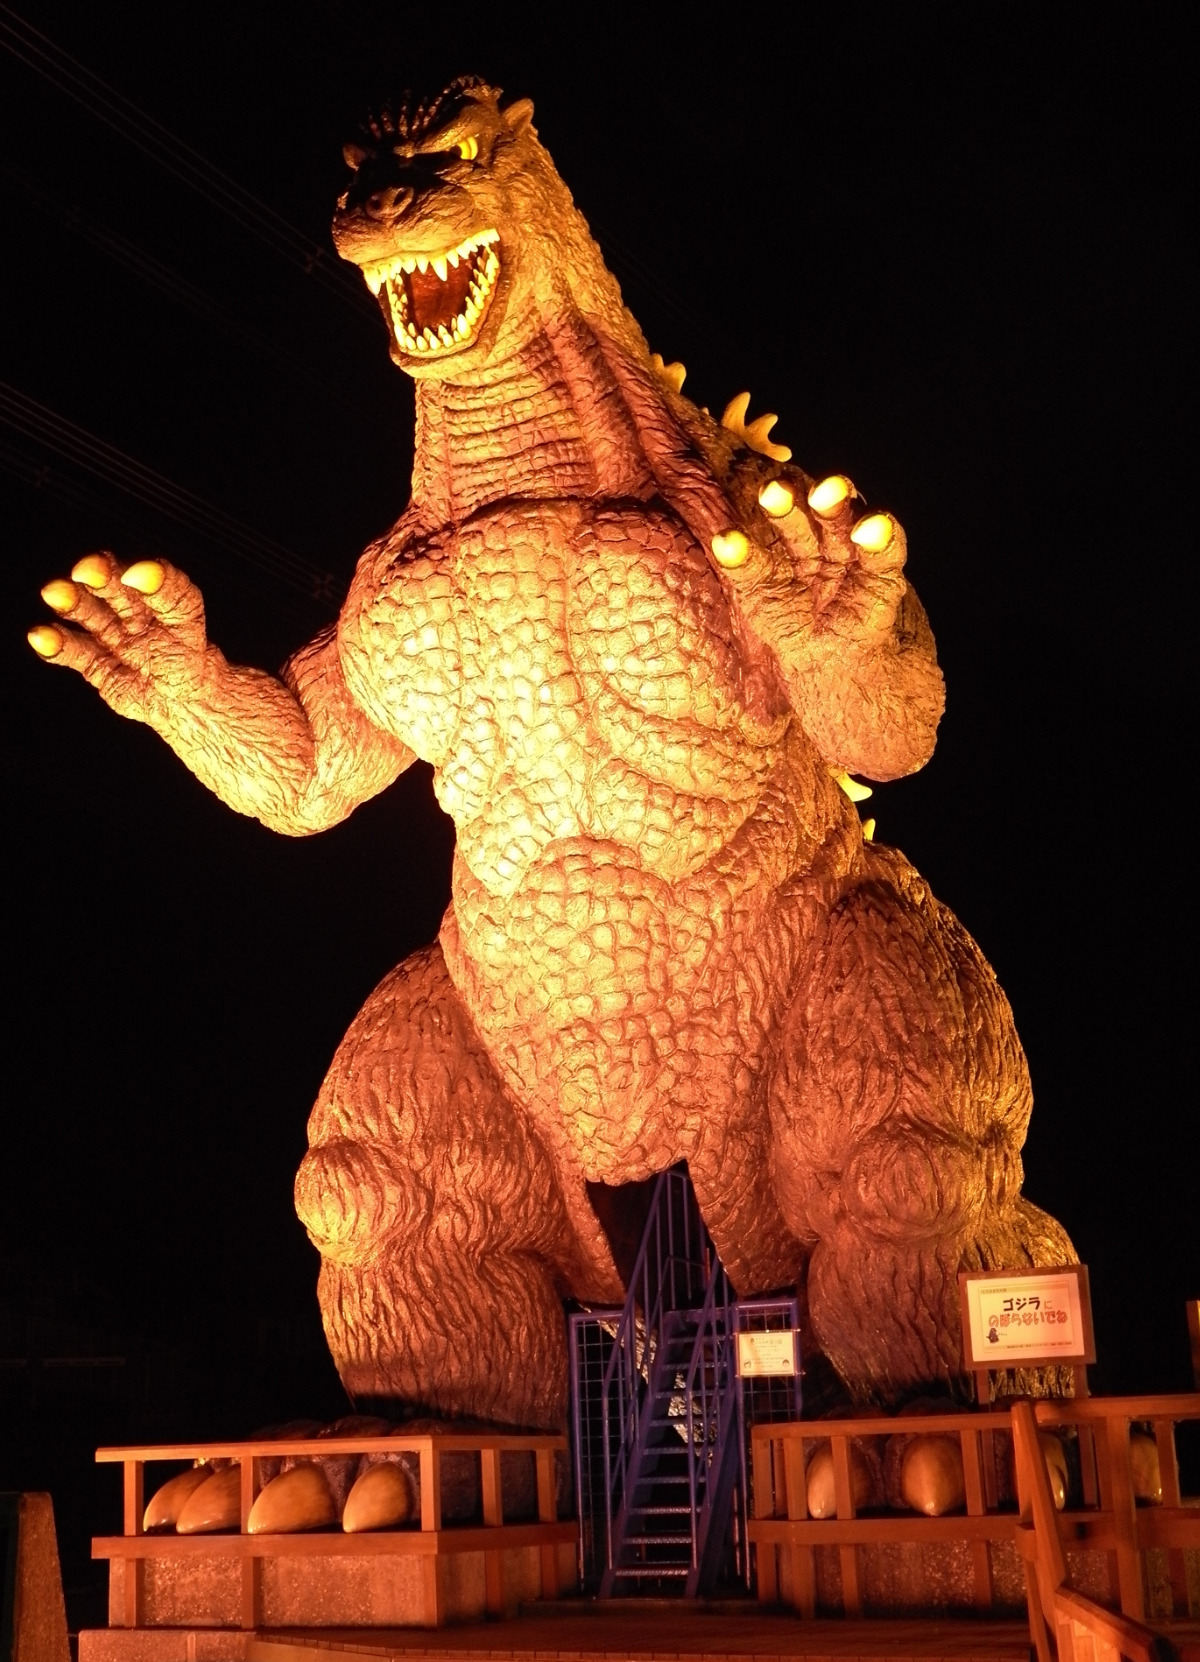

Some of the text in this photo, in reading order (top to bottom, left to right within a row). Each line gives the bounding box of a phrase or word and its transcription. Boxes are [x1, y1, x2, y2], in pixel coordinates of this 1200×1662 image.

[1003, 1296, 1053, 1312] ゴジラに
[988, 1309, 1068, 1328] のぼらないでね
